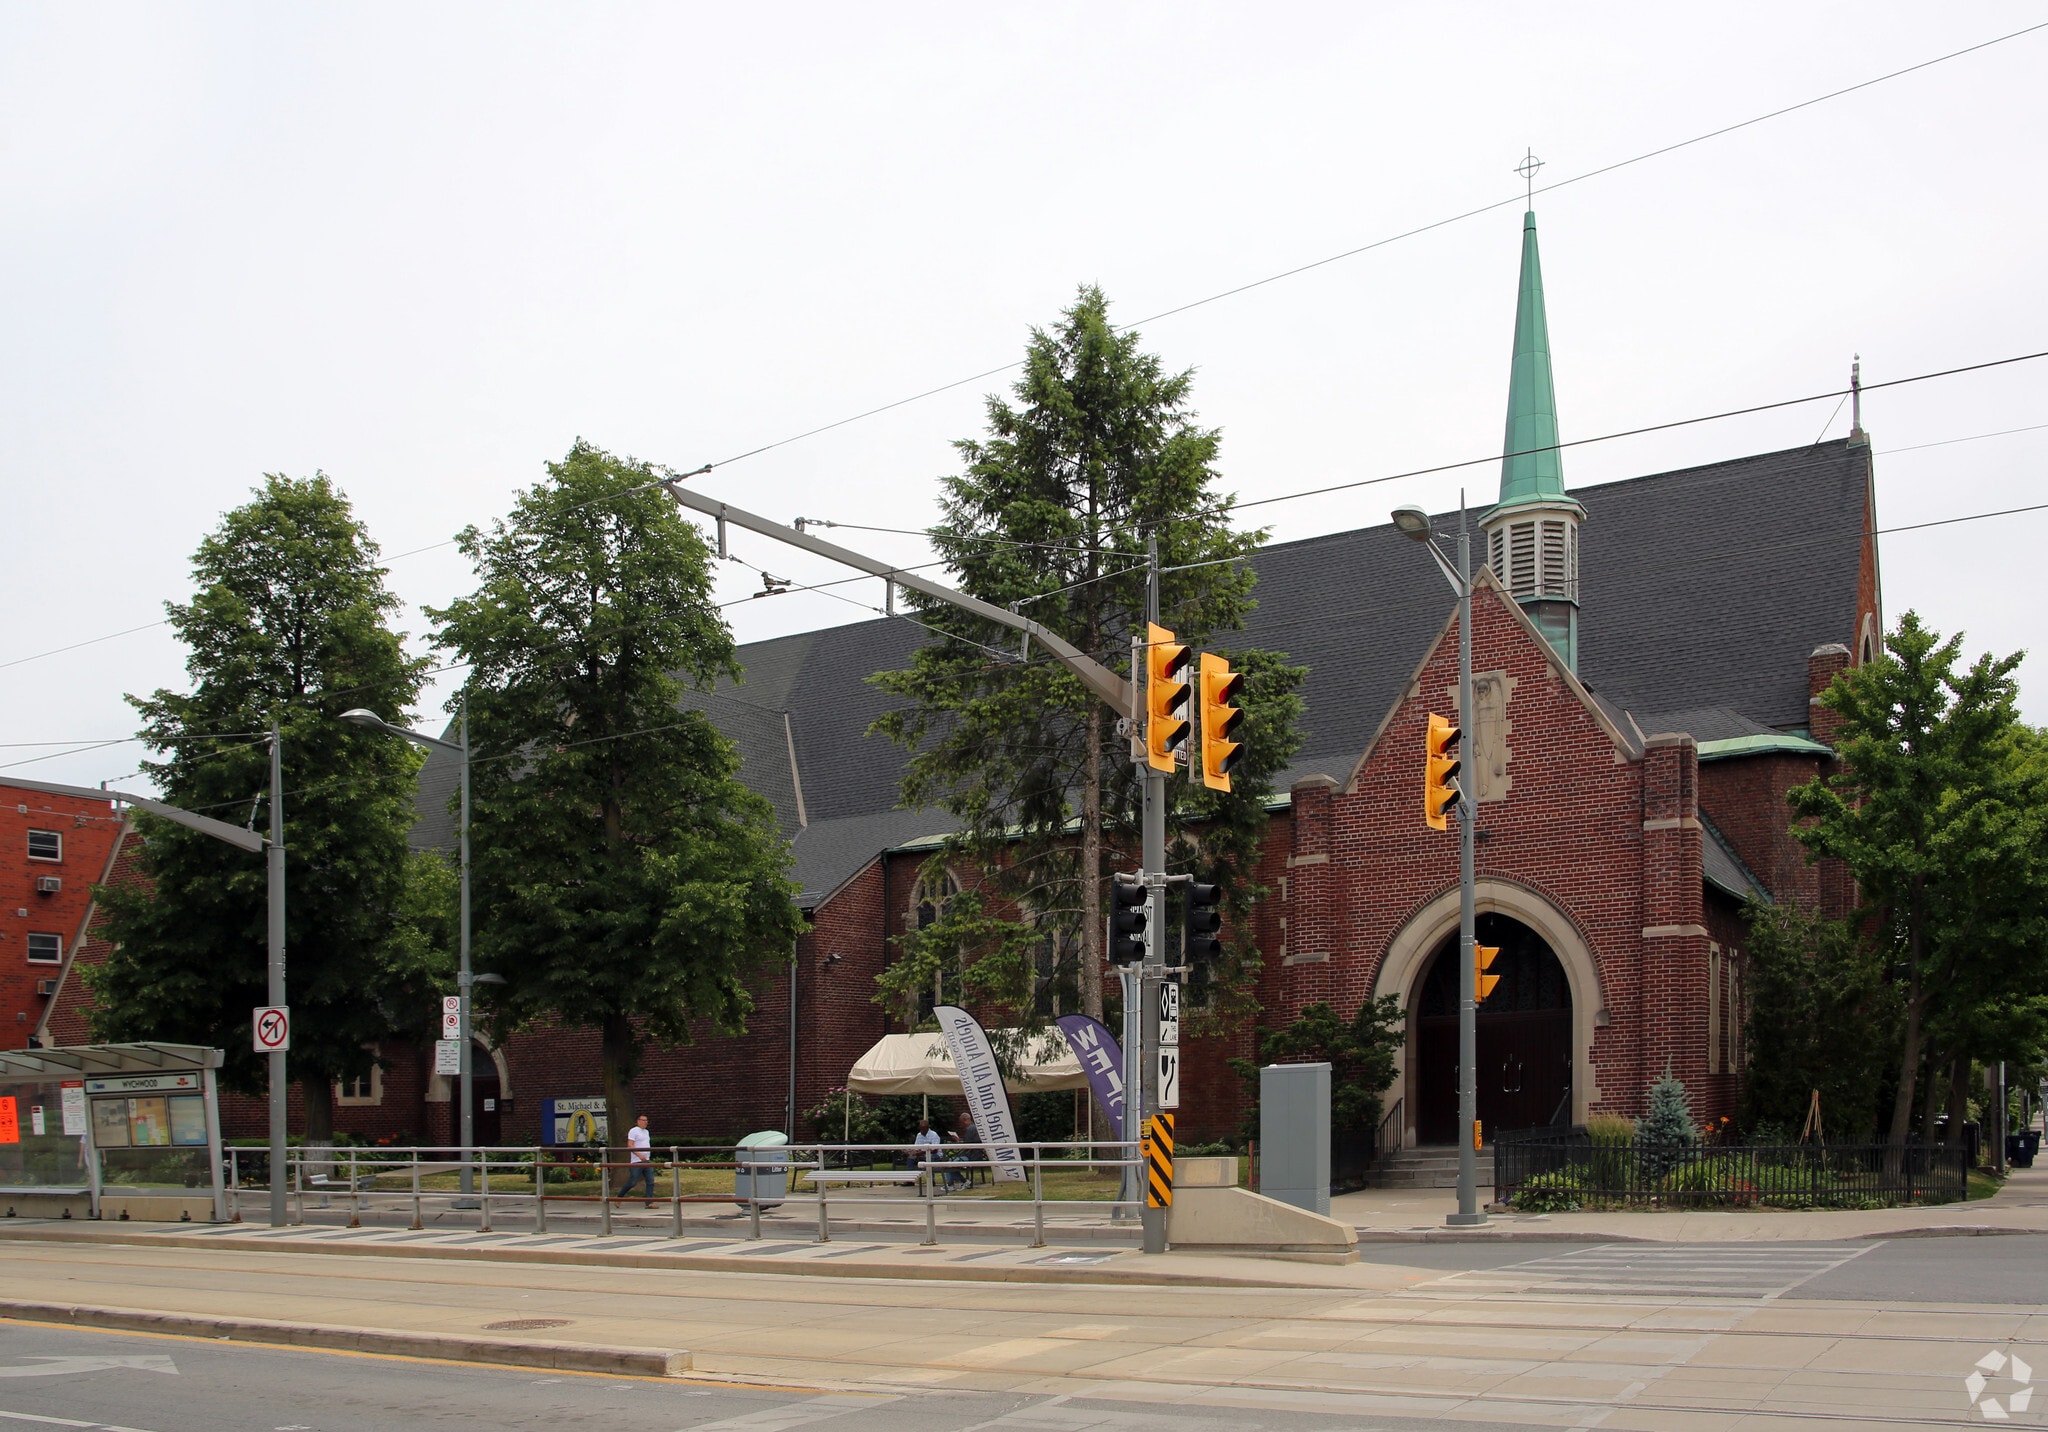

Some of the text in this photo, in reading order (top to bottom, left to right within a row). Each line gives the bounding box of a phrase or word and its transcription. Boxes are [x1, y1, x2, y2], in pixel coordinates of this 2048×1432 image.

[122, 1079, 158, 1089] WYCHWOOD
[568, 1101, 592, 1111] Michael
[593, 1101, 600, 1109] &
